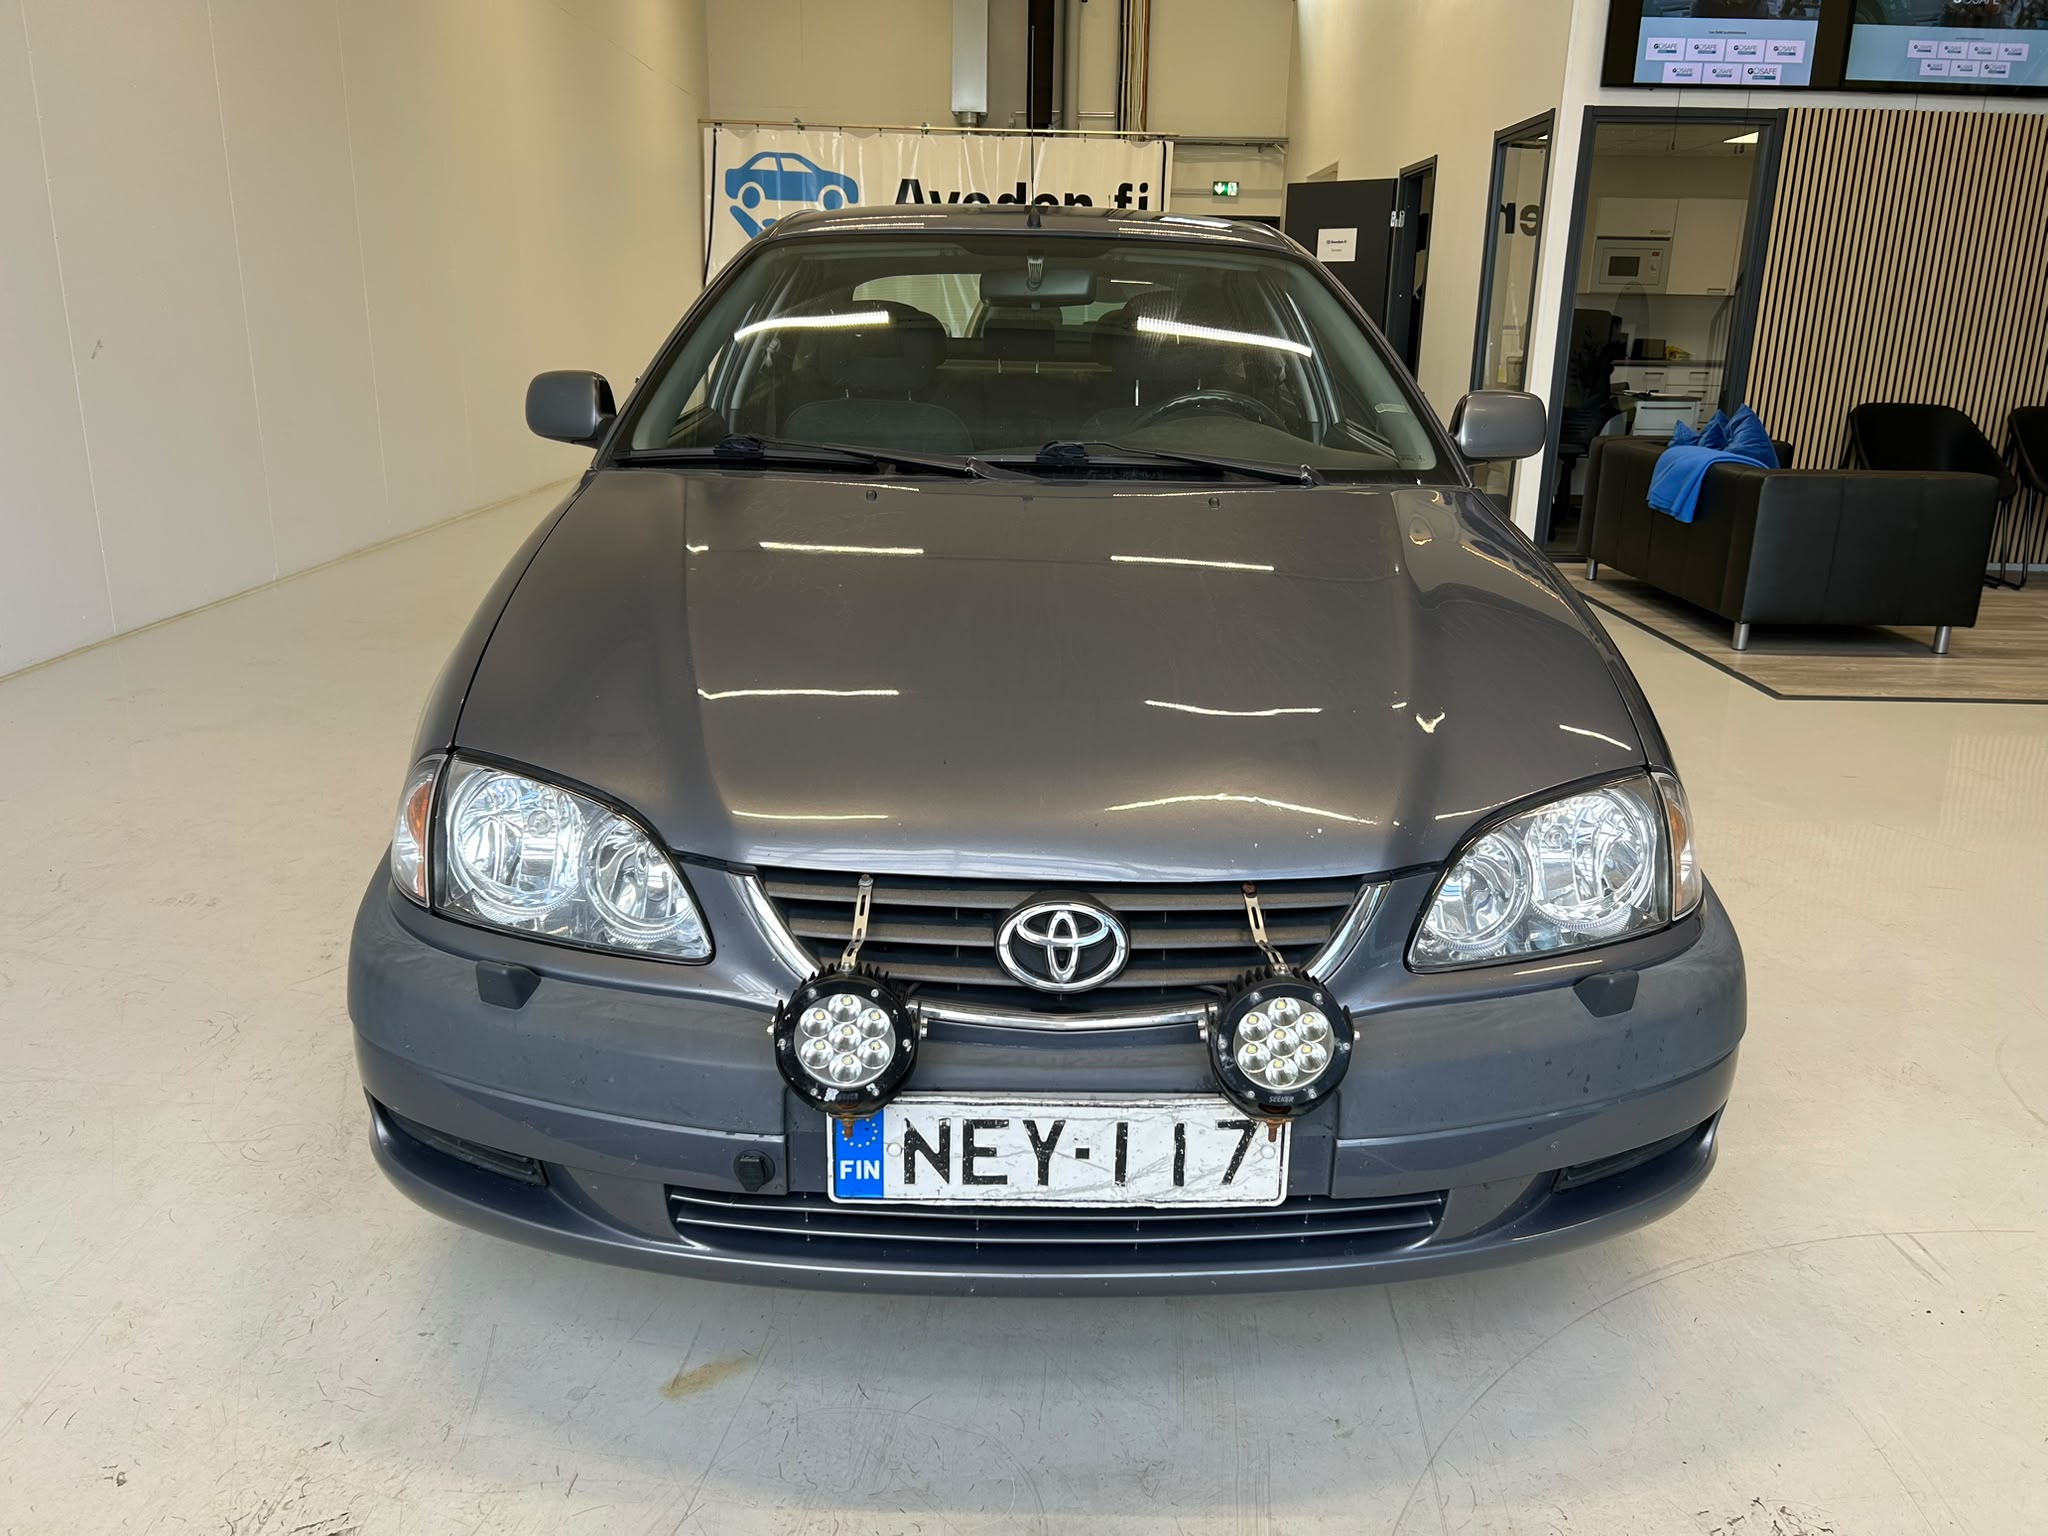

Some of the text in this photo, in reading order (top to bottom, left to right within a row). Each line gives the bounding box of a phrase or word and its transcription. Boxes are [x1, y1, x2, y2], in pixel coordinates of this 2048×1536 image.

[1747, 67, 1777, 75] GOSAFE
[1269, 1095, 1295, 1103] SEEKER
[839, 1160, 880, 1180] FIN
